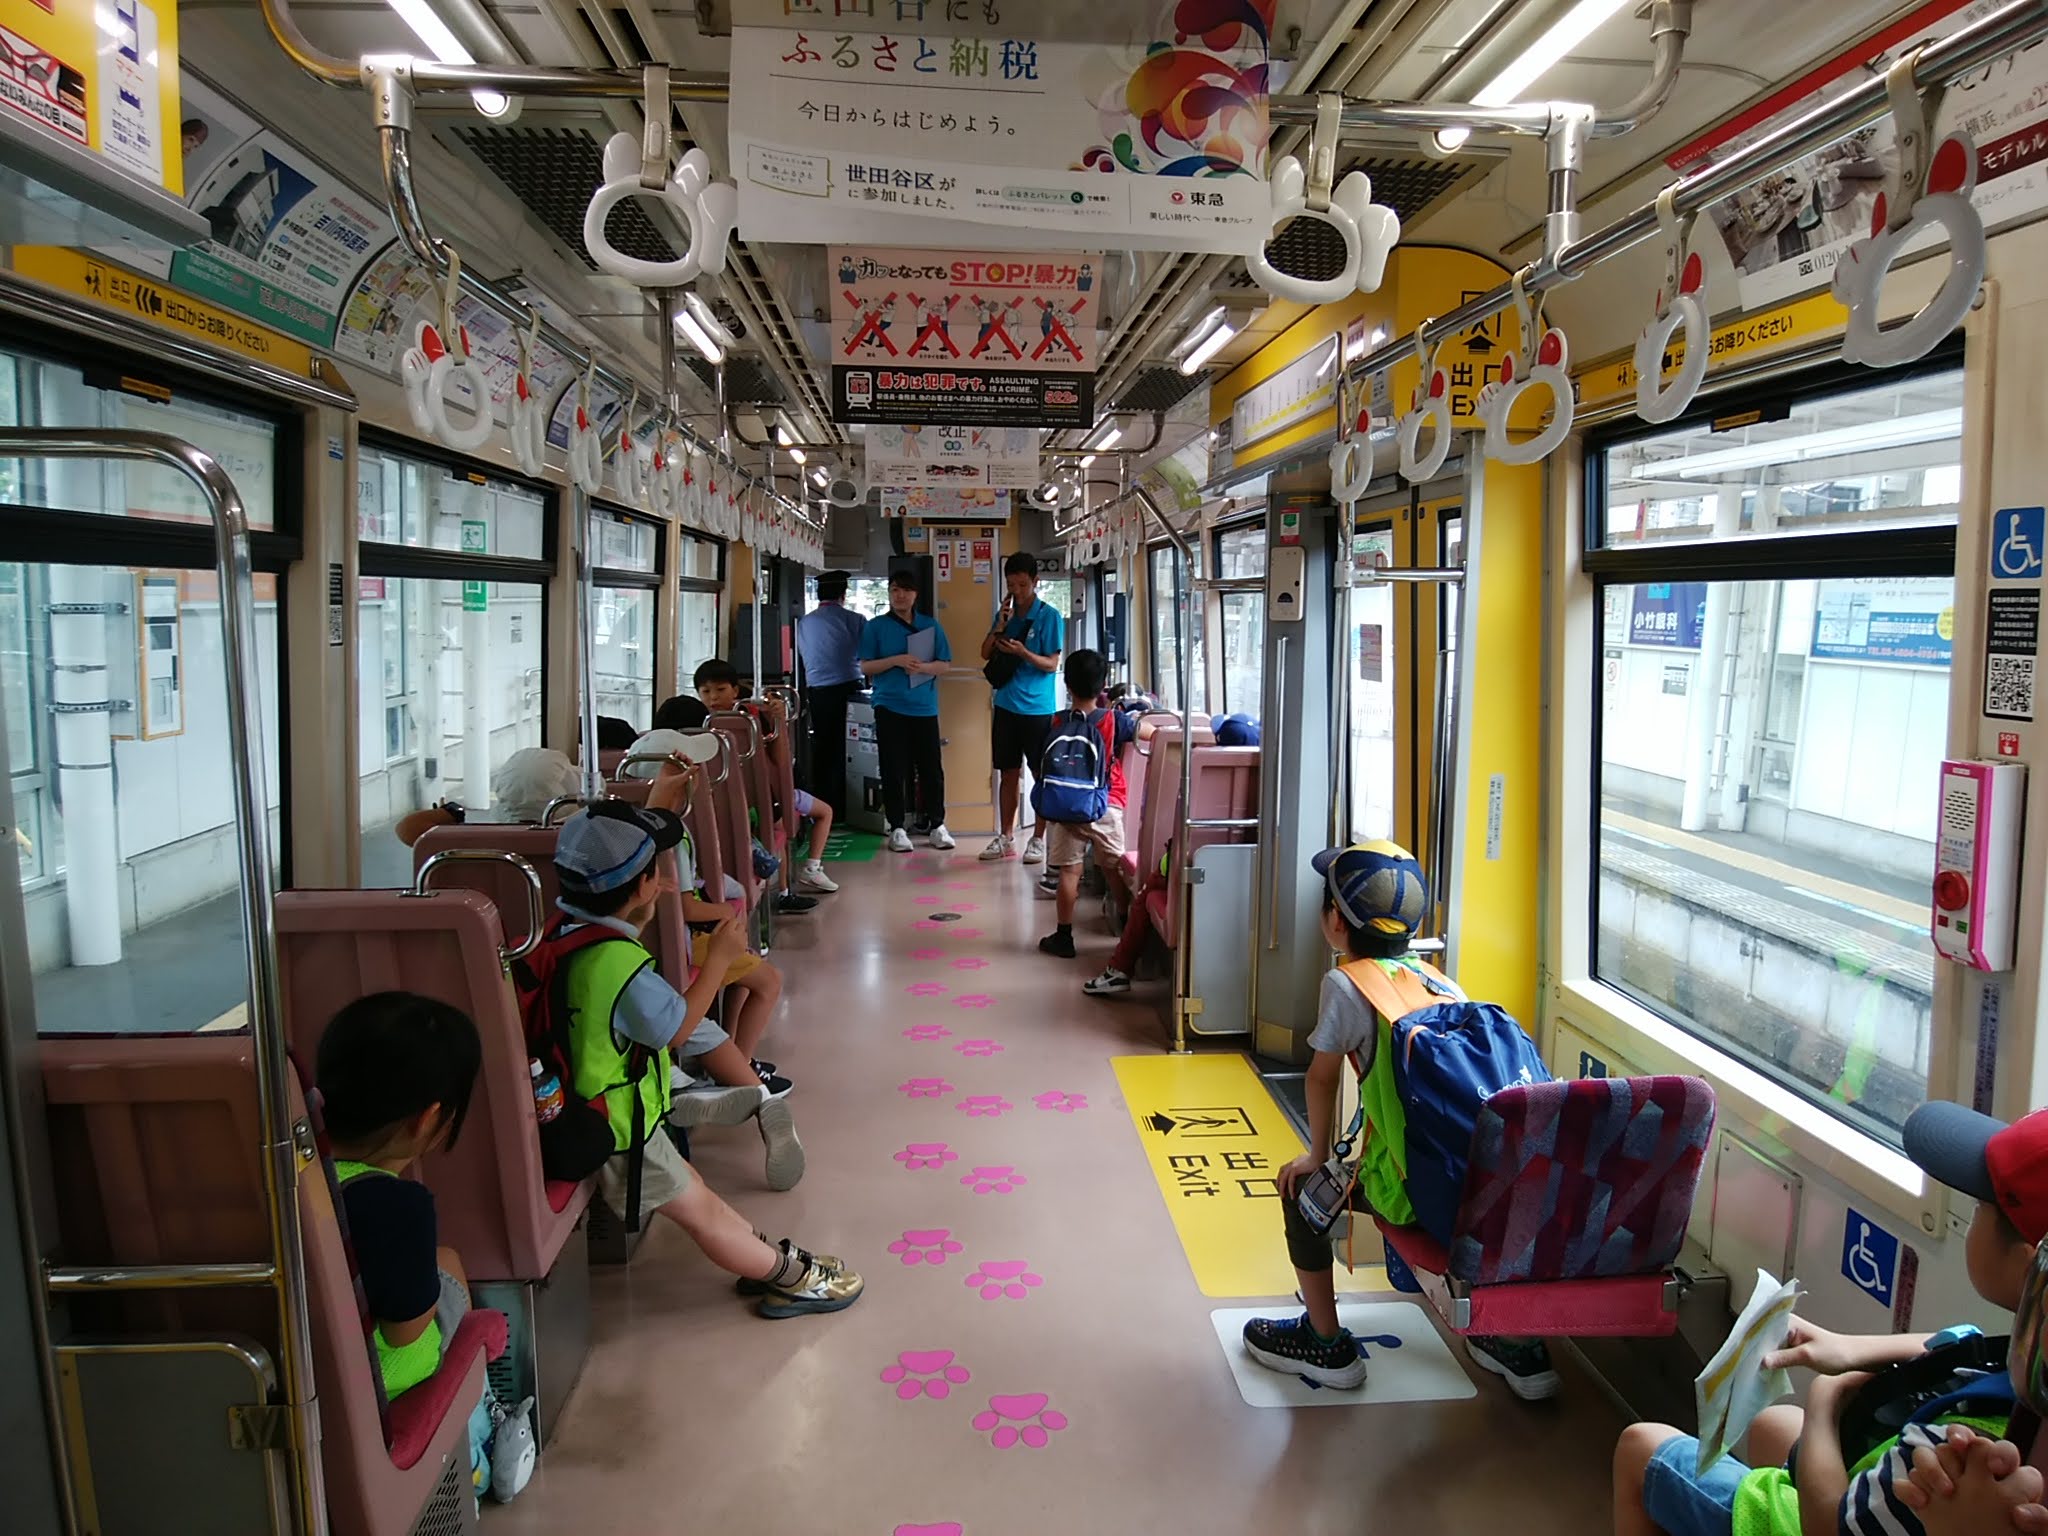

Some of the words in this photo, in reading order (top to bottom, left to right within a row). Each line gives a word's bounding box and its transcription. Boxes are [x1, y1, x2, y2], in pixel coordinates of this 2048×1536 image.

[781, 32, 1038, 80] ふるさと納税
[798, 101, 1018, 137] 今日からはじめよう。
[845, 164, 956, 191] 世田谷区が
[848, 187, 955, 210] に参加しました。
[1190, 191, 1225, 207] 東急
[856, 257, 948, 280] カッとなっても
[110, 276, 131, 295] 出口
[166, 299, 269, 353] 出口からお降りください
[877, 371, 987, 392] 暴力は犯罪です。
[989, 376, 1040, 385] ASSAULTING
[1005, 385, 1033, 393] CRIME.
[1634, 611, 1678, 630] 小竹眼科
[2000, 733, 2017, 742] SOS
[1168, 1154, 1220, 1198] Exit
[1219, 1152, 1281, 1198] 出口
